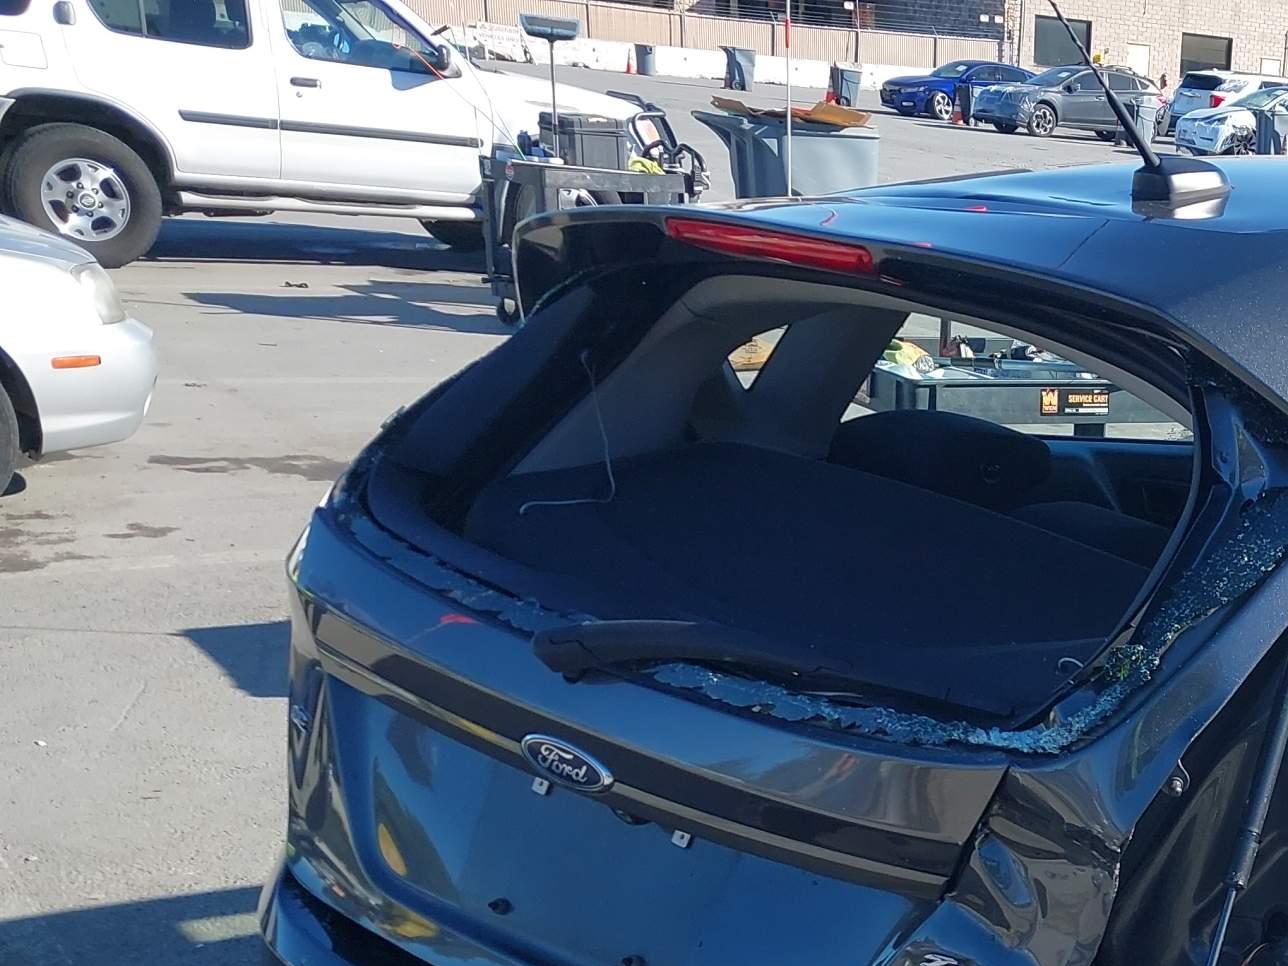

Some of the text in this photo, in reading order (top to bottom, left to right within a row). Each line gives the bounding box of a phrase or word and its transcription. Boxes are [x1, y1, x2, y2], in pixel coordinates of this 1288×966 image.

[1068, 394, 1109, 404] SERVICE CART
[537, 743, 589, 783] Ford
